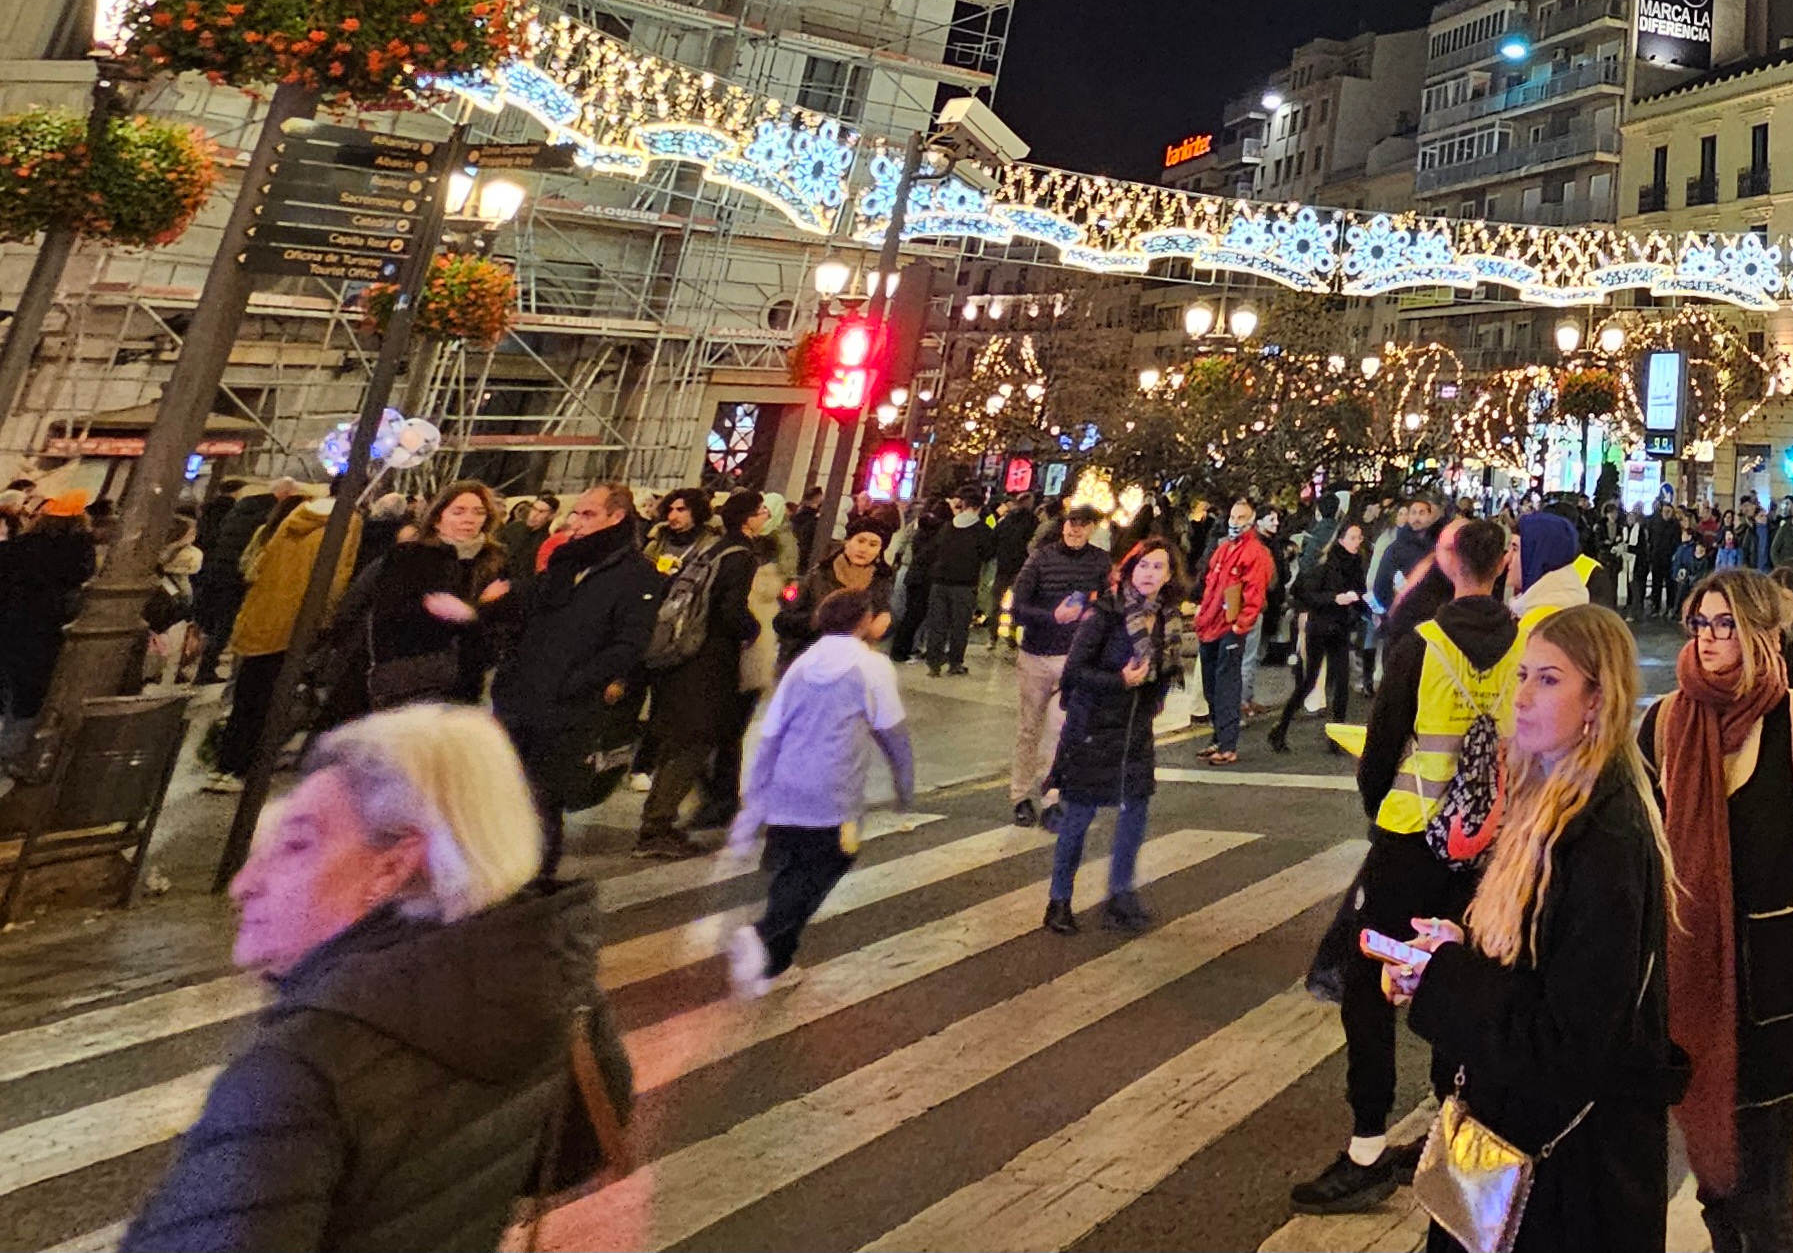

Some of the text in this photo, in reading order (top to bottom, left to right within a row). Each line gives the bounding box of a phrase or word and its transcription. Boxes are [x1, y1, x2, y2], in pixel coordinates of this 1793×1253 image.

[1693, 9, 1711, 27] LA
[1639, 16, 1711, 42] DIFERENCIA
[582, 204, 659, 221] ALQUISUR
